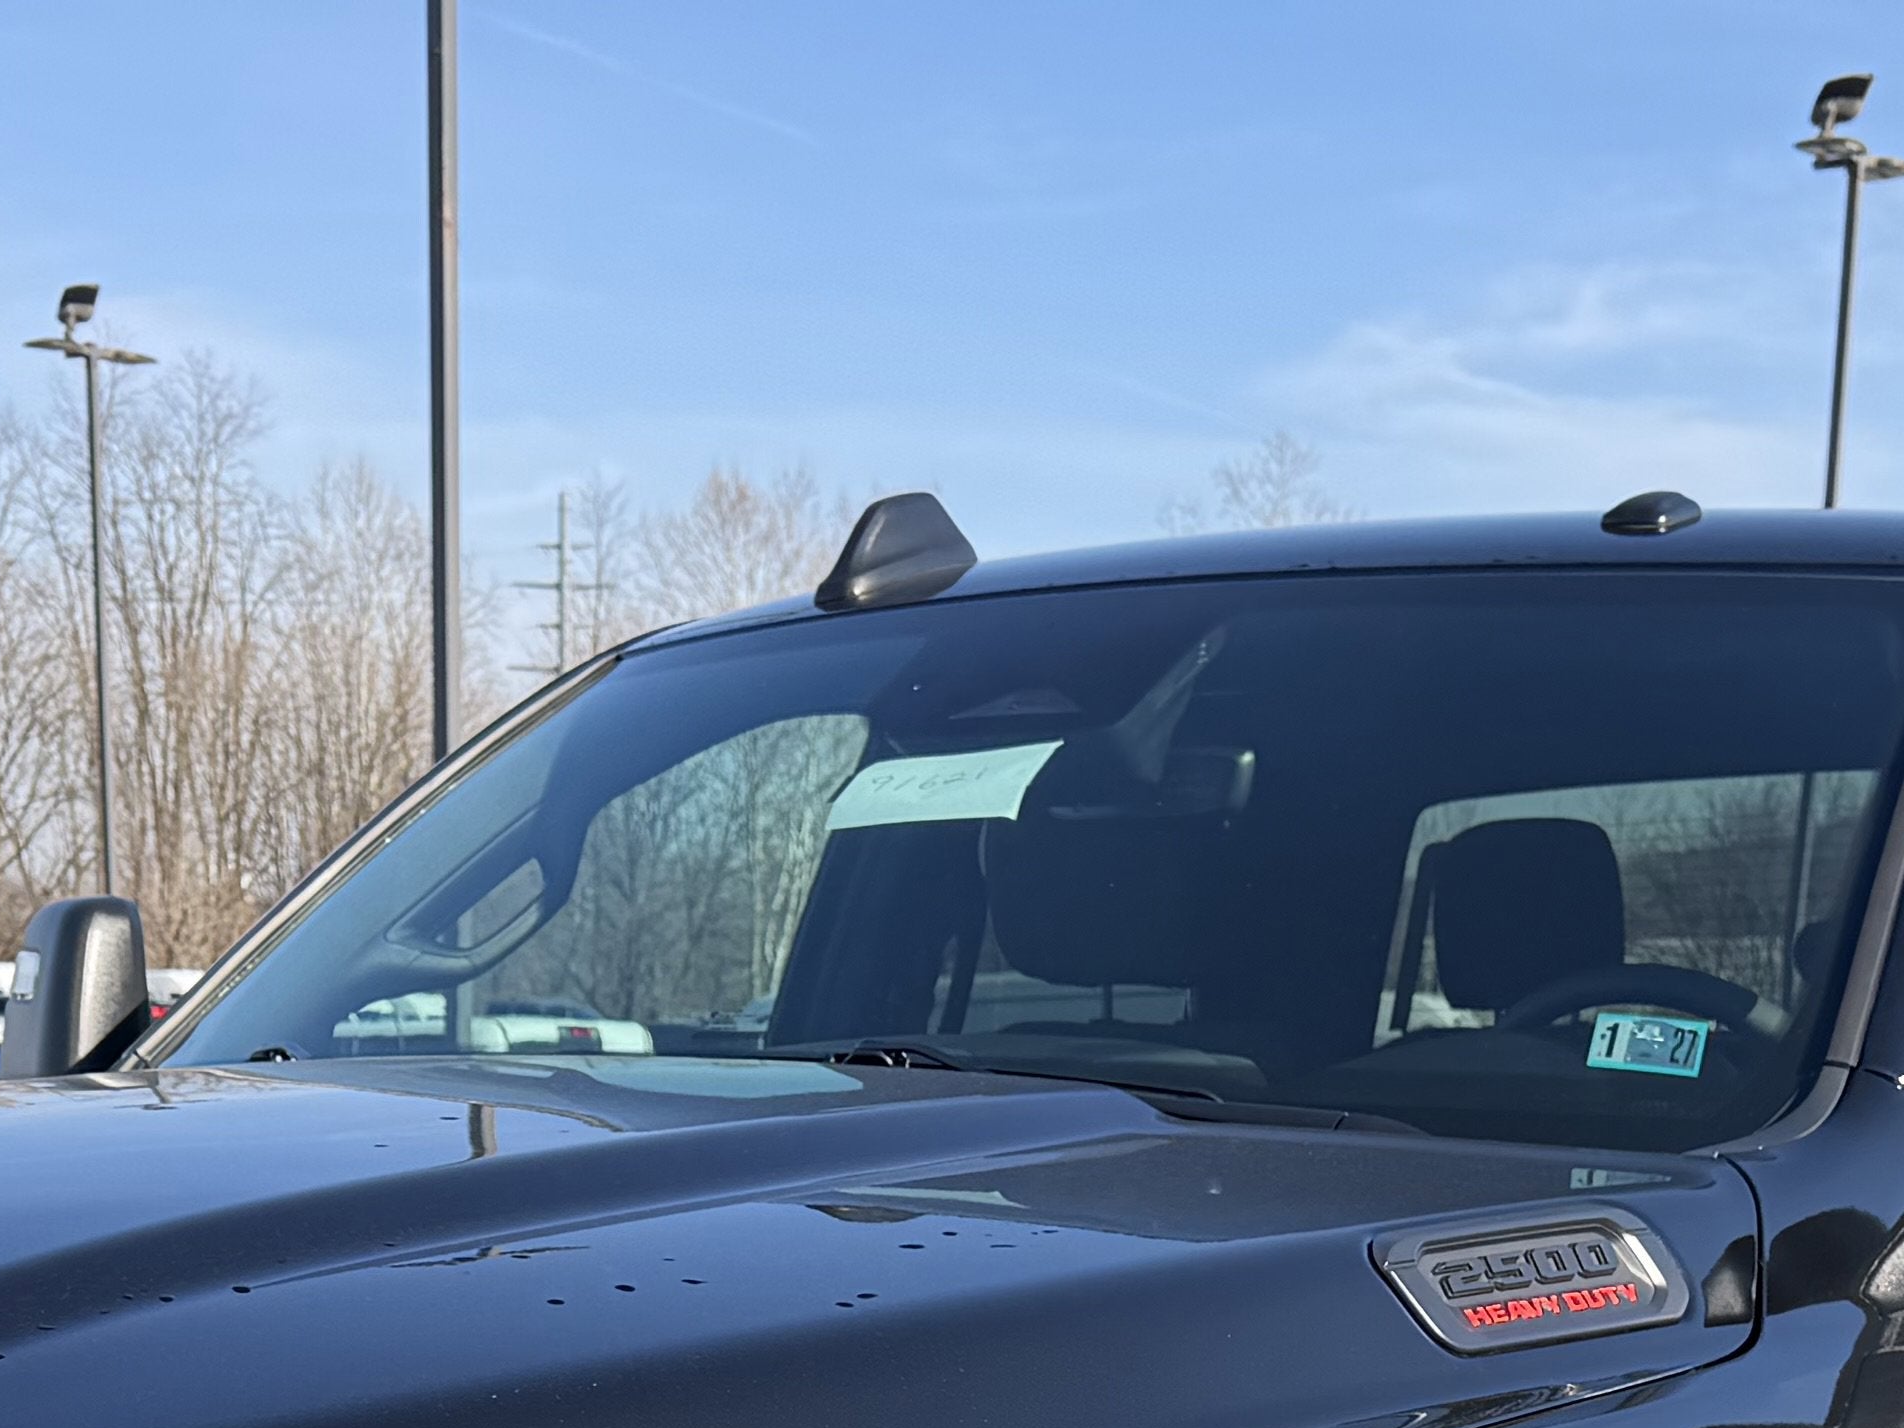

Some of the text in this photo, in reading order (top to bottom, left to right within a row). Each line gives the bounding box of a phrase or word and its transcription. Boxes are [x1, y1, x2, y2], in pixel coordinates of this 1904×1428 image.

[1670, 1027, 1699, 1067] 27
[1430, 1239, 1619, 1300] 2500
[1463, 1283, 1638, 1328] HEAVY DUTY
